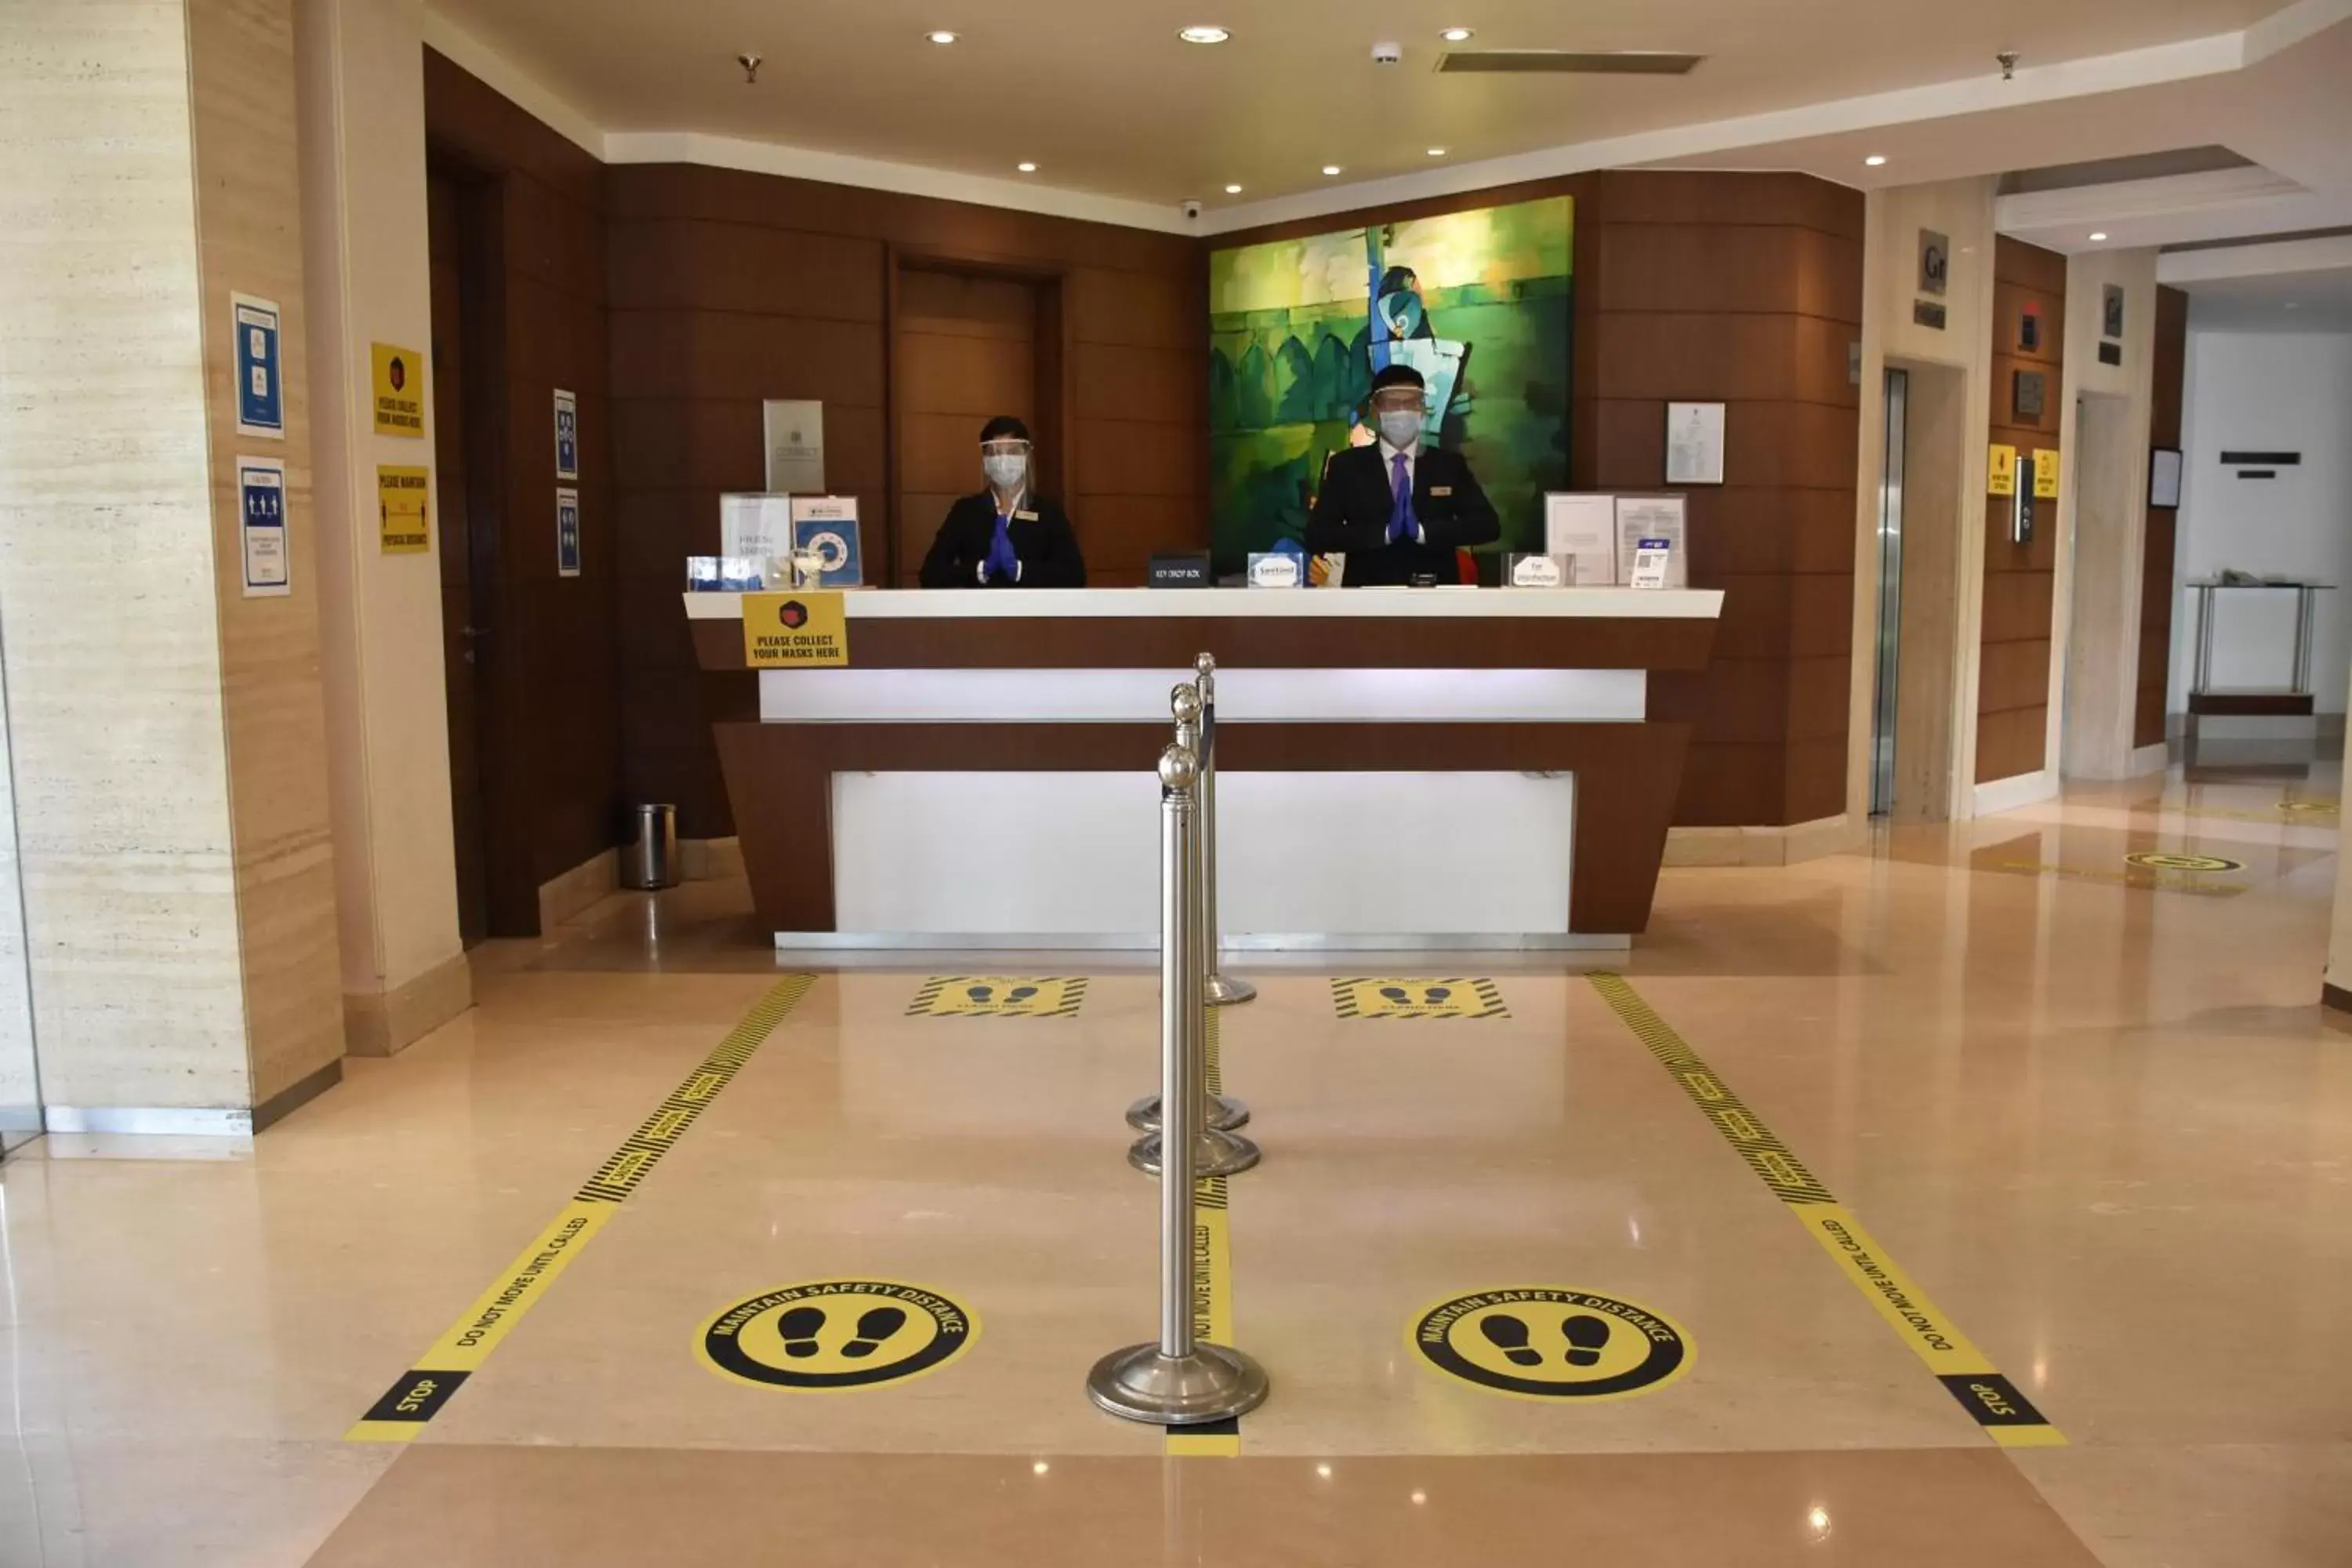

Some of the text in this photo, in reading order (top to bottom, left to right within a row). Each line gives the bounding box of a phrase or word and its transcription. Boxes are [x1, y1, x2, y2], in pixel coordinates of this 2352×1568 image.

[753, 647, 840, 659] YOUR MASKS HERE
[757, 634, 833, 647] PLEASE COLLECT
[456, 1218, 588, 1346] DO NOT MOVE UNTIL CALLED
[1821, 1219, 1954, 1350] DO NOT MOVE UNTIL CALLED
[713, 1283, 964, 1337] MAINTAIN SAFETY DISTANCE
[1421, 1290, 1675, 1343] MAINTAIN SAFETY DISTANCE
[395, 1378, 439, 1413] STOP
[1970, 1383, 2016, 1416] STOP
